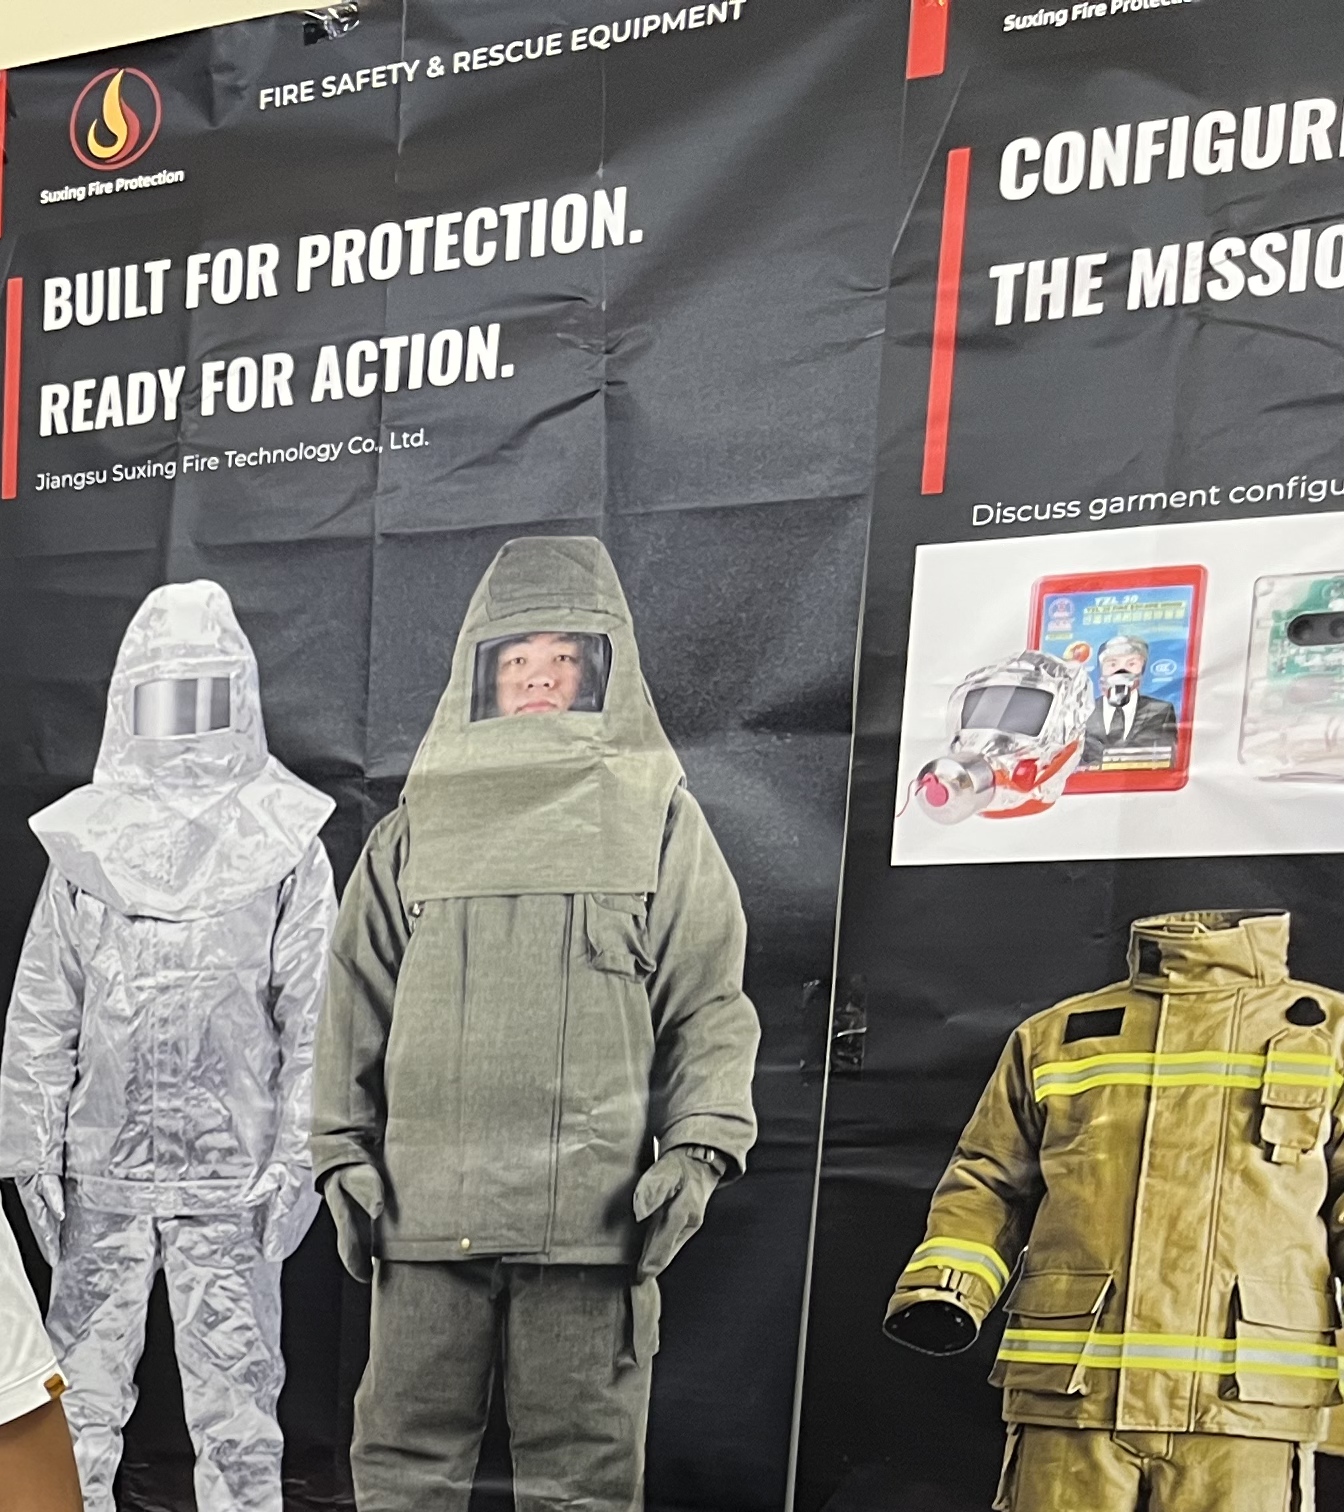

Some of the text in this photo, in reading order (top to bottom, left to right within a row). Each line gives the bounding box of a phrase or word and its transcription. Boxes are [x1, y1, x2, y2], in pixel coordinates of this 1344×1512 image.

[1004, 9, 1068, 31] Suxing
[1072, 2, 1107, 20] Fire
[260, 0, 746, 109] FIRE SAFETY & RESCUE EQUIPMENT
[1000, 98, 1344, 200] CONFIGUR
[40, 170, 184, 204] Suxing Fire Protection
[44, 187, 643, 331] BUILT FOR PROTECTION.
[989, 253, 1107, 325] THE
[40, 323, 514, 436] READY FOR ACTION.
[36, 470, 106, 490] Jiangsu
[113, 460, 176, 481] Suxing
[183, 454, 219, 473] Fire
[225, 442, 343, 467] Technology
[391, 428, 429, 449] Ltd.
[973, 501, 1081, 525] Discuss
[1089, 486, 1220, 520] garment
